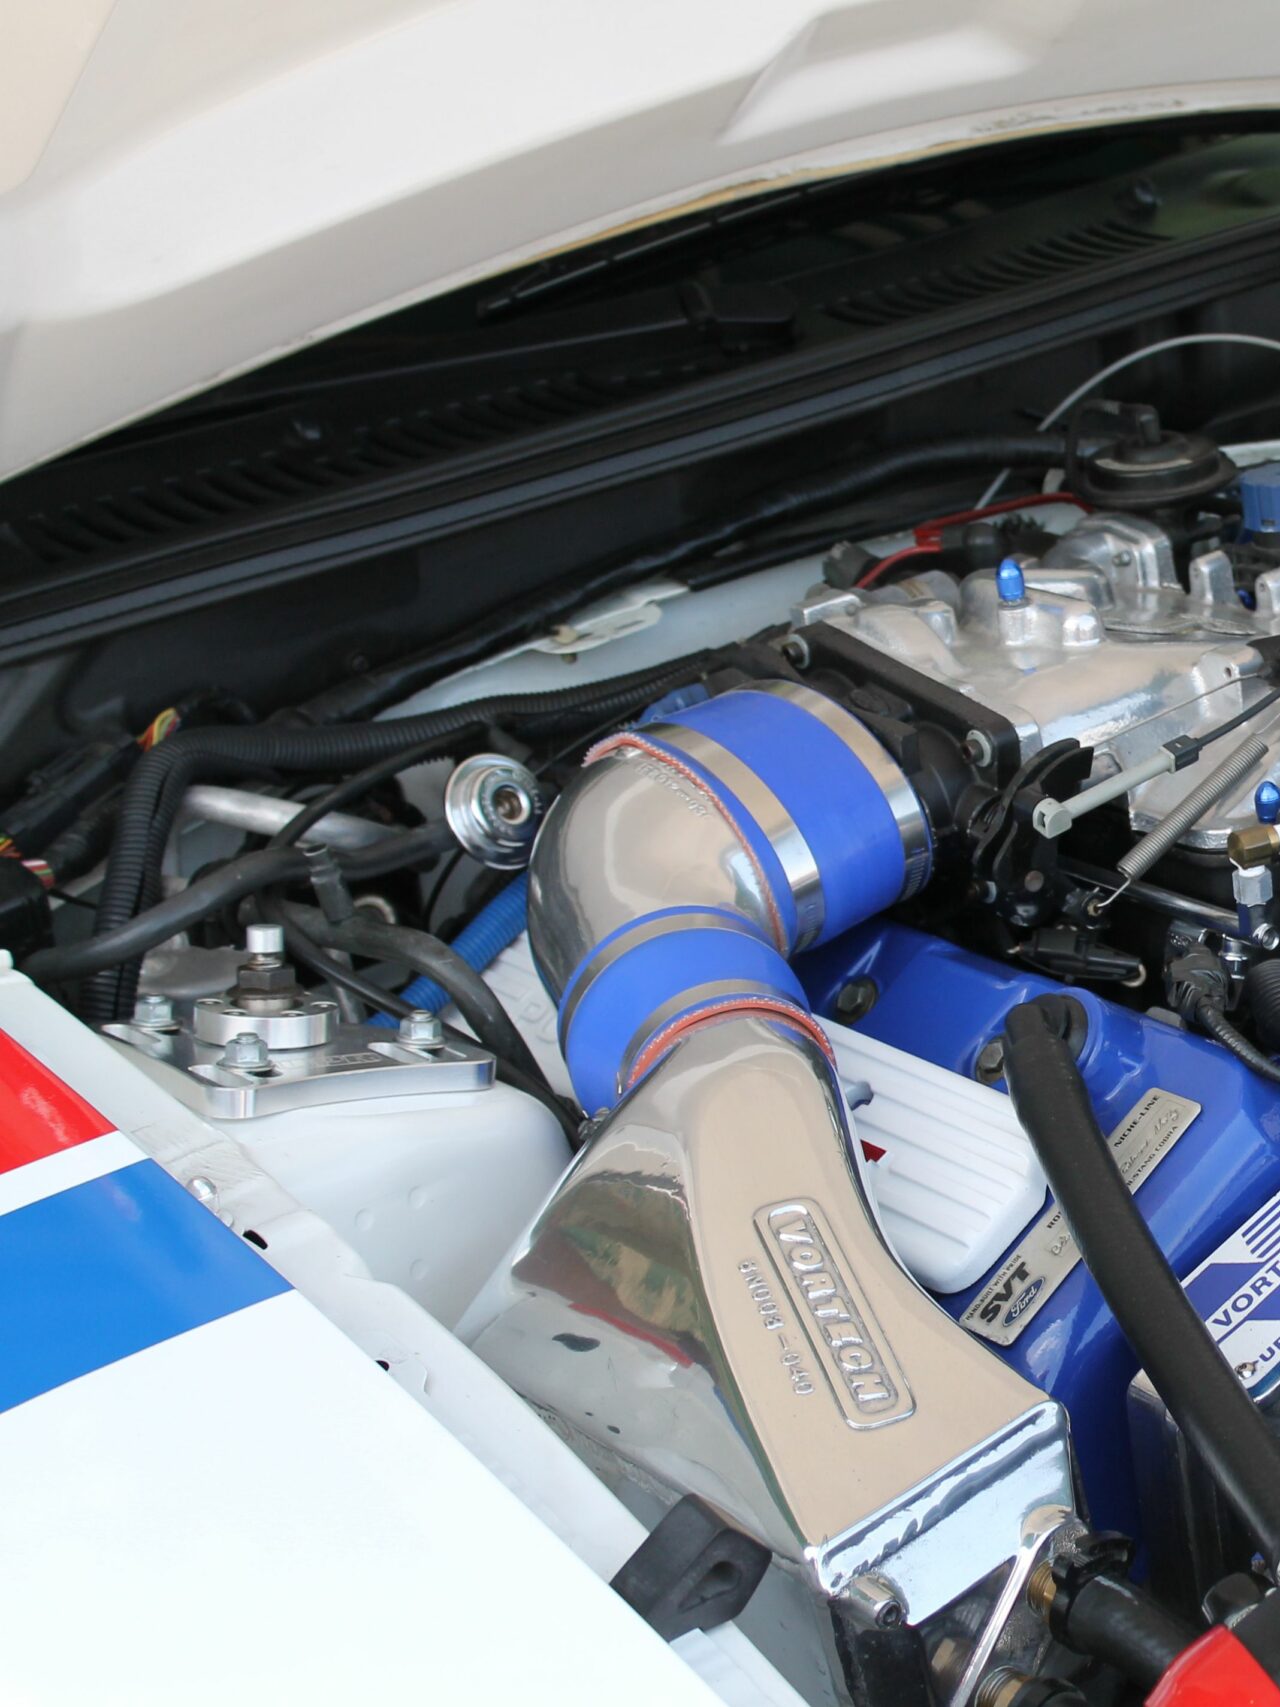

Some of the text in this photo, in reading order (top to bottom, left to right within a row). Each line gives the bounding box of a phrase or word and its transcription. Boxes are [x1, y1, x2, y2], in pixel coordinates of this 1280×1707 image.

[1113, 1095, 1160, 1148] NICHE-LINE
[1154, 1125, 1178, 1152] COBRA
[980, 1261, 1030, 1323] SVT
[994, 1271, 1008, 1287] WITH
[1006, 1254, 1021, 1271] PRIDE
[777, 1218, 891, 1401] VORTECH
